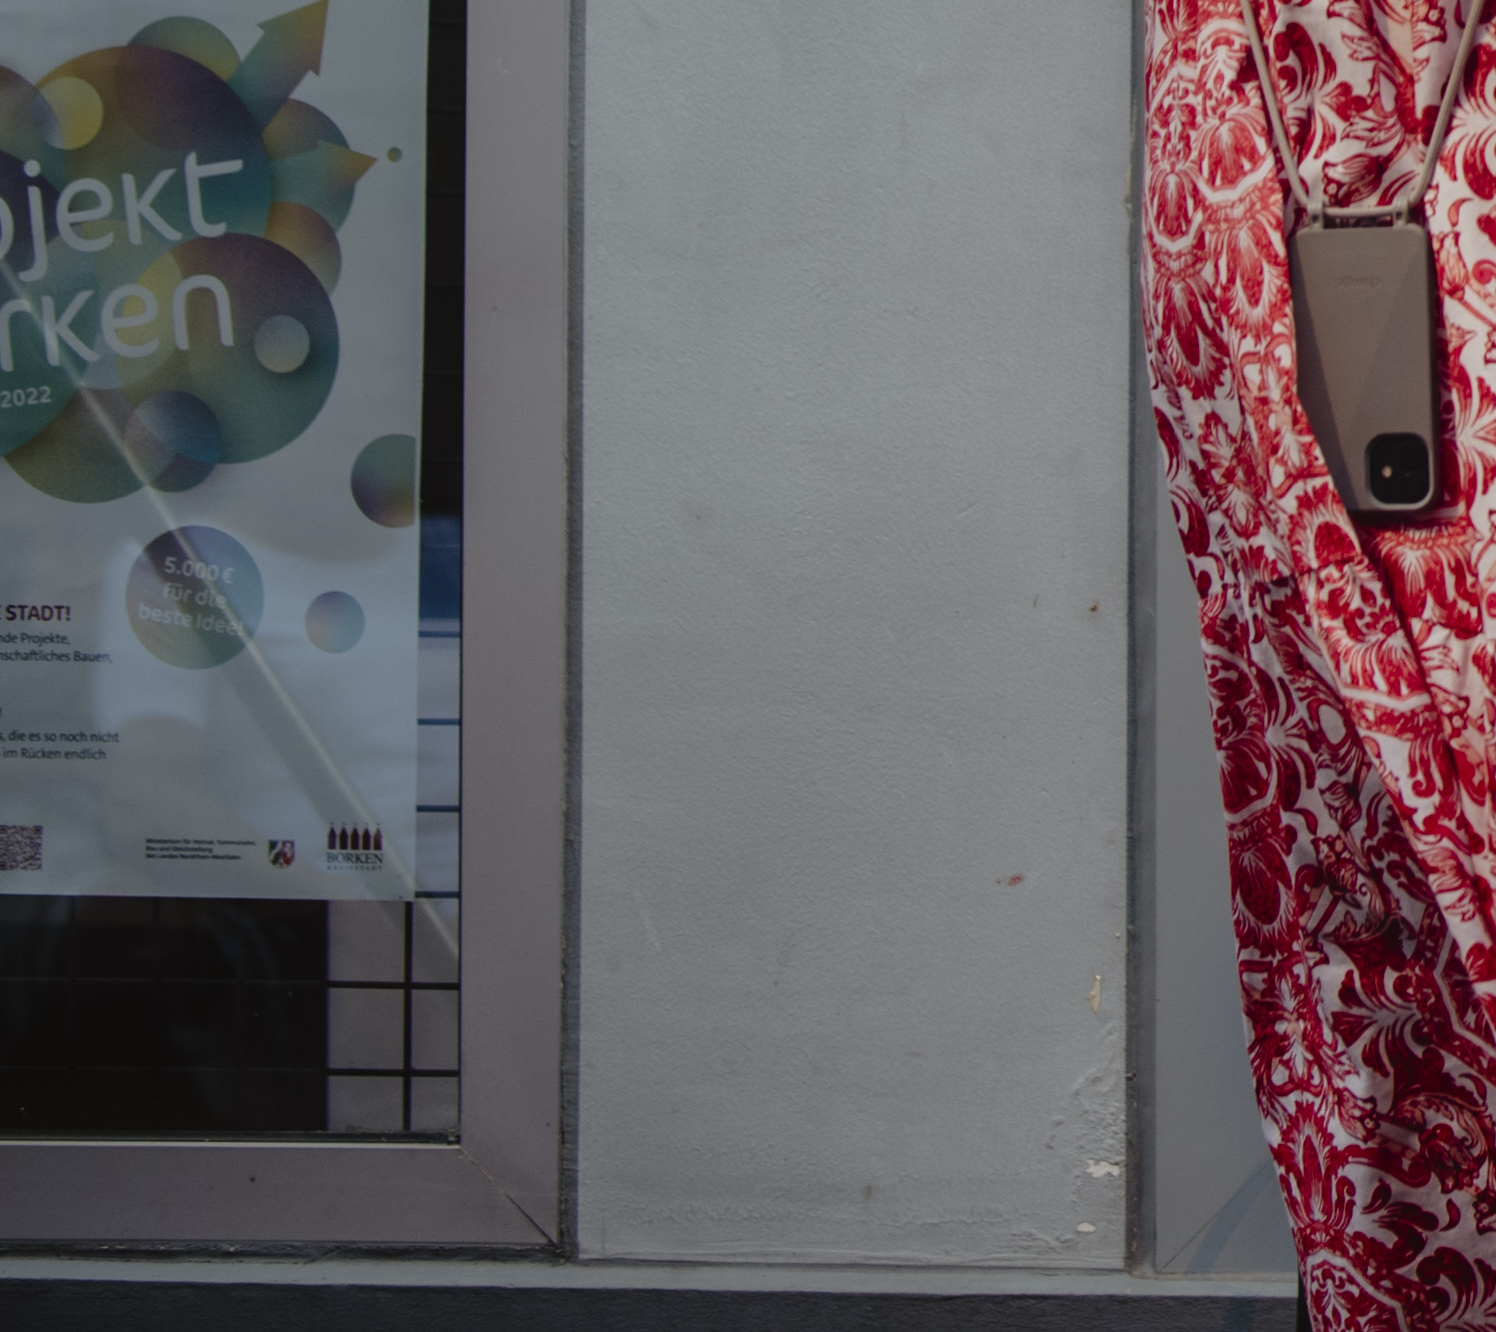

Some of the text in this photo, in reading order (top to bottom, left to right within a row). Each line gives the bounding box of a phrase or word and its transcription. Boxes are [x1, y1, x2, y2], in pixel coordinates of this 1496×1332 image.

[0, 151, 244, 283] jekt
[0, 385, 53, 409] 2022
[163, 556, 234, 585] 5.000 €
[162, 582, 192, 603] für
[5, 604, 71, 622] STADT!
[138, 601, 193, 628] beste
[20, 632, 71, 648] Projekte,
[8, 730, 26, 743] die
[28, 732, 41, 743] es
[44, 732, 58, 743] so
[59, 730, 88, 743] noch
[90, 730, 120, 743] nicht
[3, 747, 107, 760] im Rücken endlich
[327, 852, 384, 865] BORKEN
